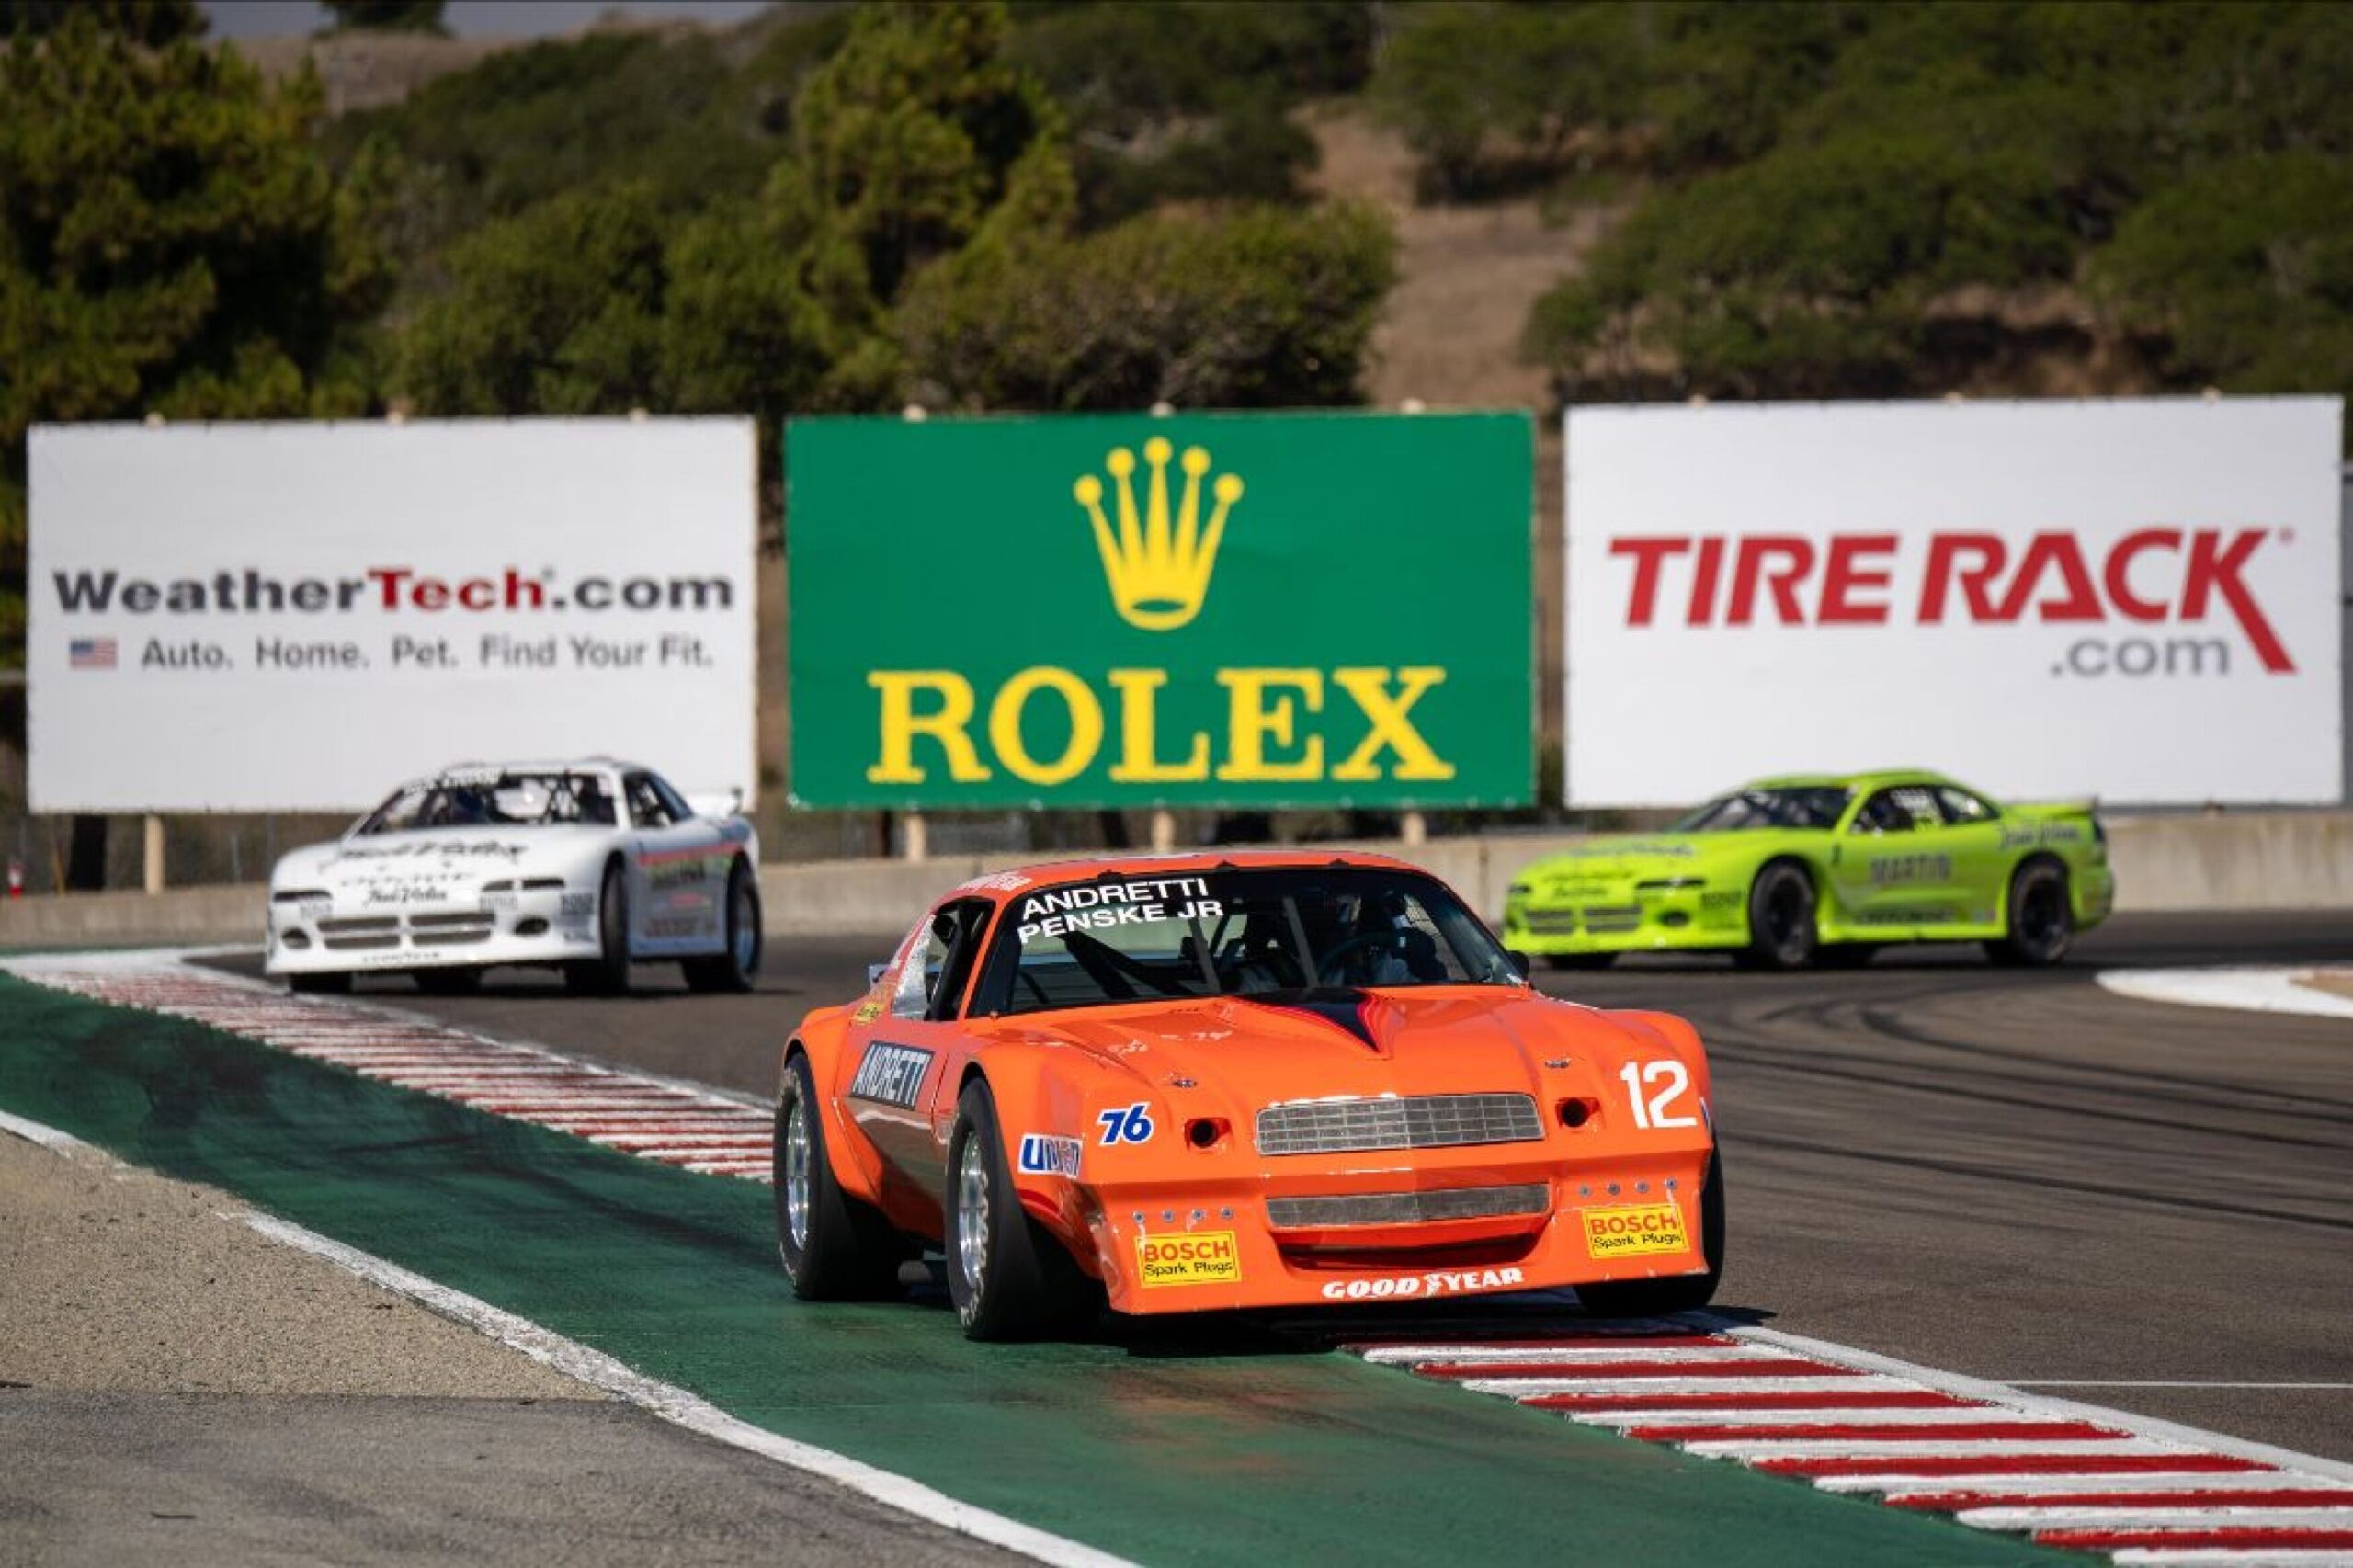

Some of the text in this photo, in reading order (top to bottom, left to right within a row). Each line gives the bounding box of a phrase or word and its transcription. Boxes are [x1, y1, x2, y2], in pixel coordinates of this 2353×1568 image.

[52, 566, 733, 613] WeatherTech.com
[1610, 529, 2298, 674] TIRE RACK
[142, 635, 713, 668] Auto. Home. Pet. Find Your Fit.
[2051, 637, 2232, 678] .com
[867, 665, 1456, 785] ROLEX
[1021, 877, 1210, 922] ANDRETTI
[1017, 900, 1225, 945] PENSKE JR
[851, 1043, 932, 1108] ANDRETTI
[1619, 1060, 1698, 1130] 12
[1098, 1102, 1154, 1144] 76
[1589, 1212, 1677, 1236] BOSCH
[1593, 1231, 1681, 1250] Spark Plugs
[1144, 1239, 1231, 1263] BOSCH
[1144, 1261, 1233, 1278] Spark Plugs
